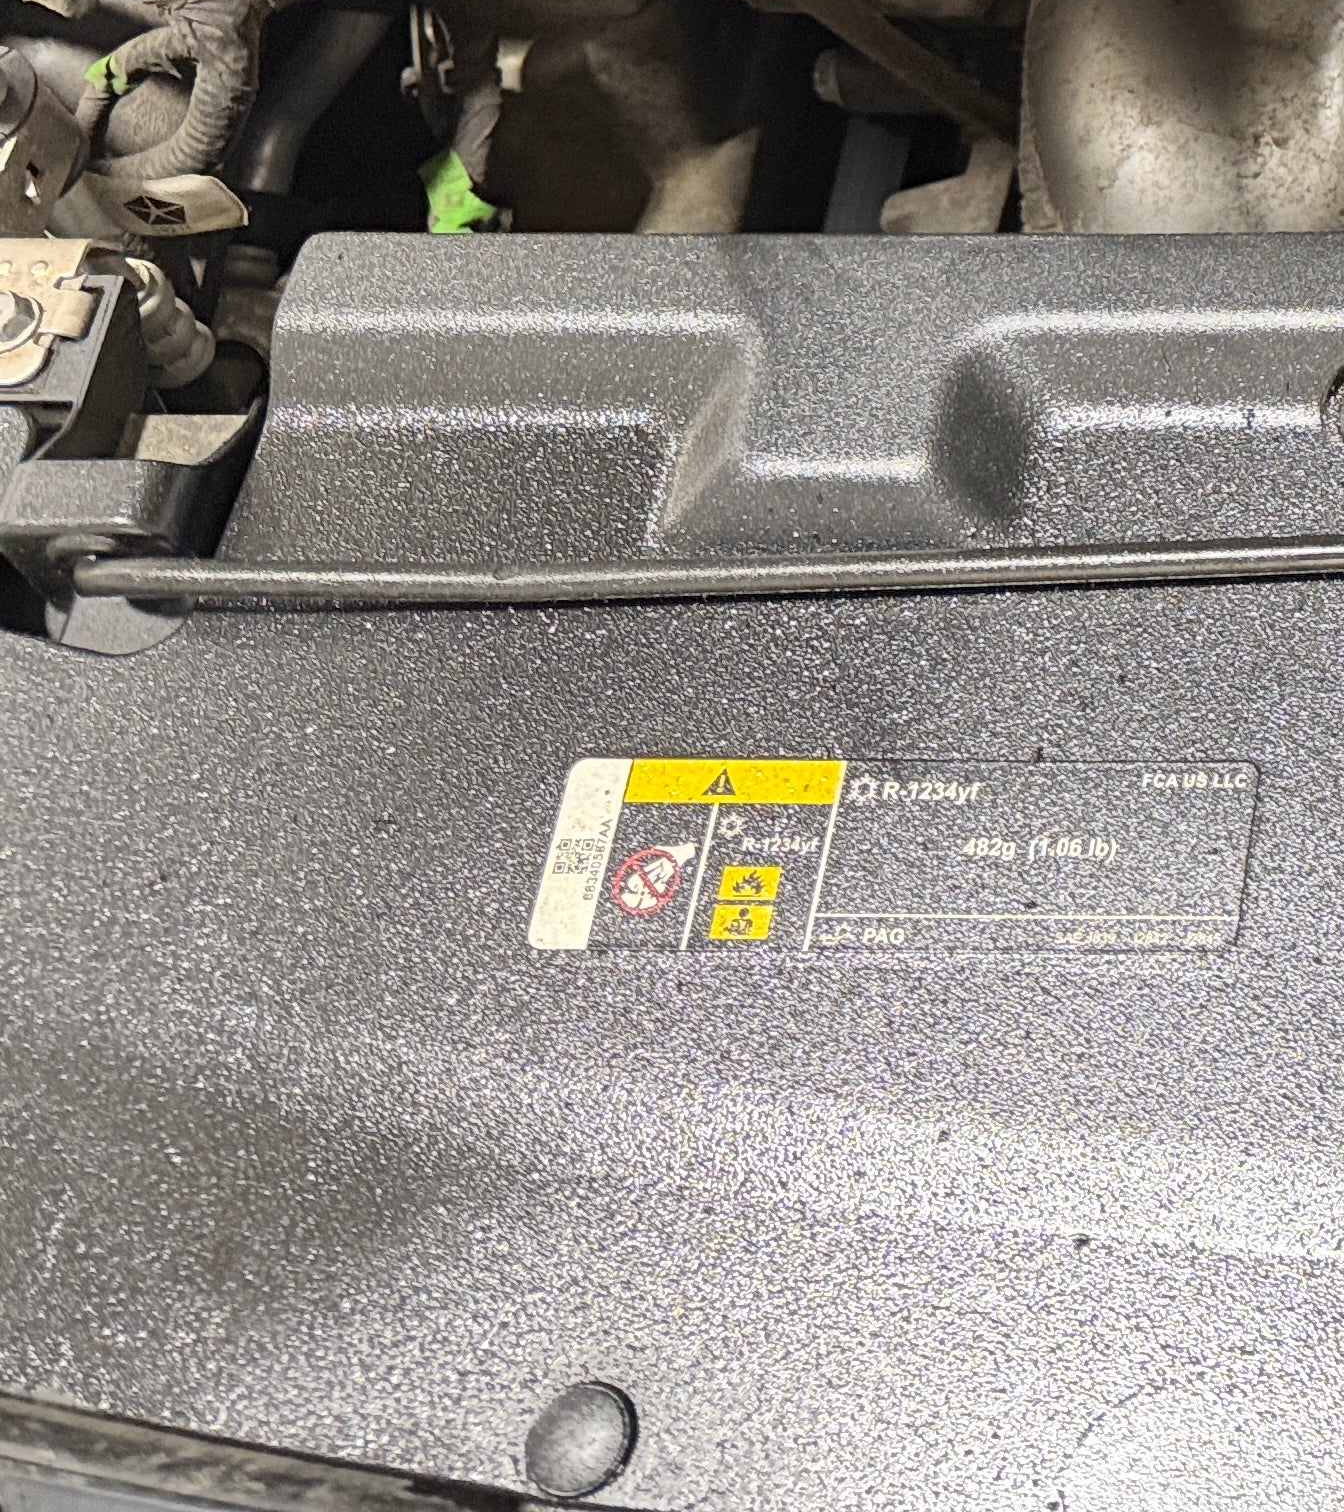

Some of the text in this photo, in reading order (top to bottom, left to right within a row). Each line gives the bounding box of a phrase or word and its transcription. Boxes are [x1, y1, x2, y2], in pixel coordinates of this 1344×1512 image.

[882, 780, 981, 801] R-1234yf
[1142, 772, 1248, 789] FCA US LLC
[741, 835, 820, 855] R-1234yf
[962, 837, 1120, 864] 482g (1.06 lb)
[862, 927, 905, 945] PAG
